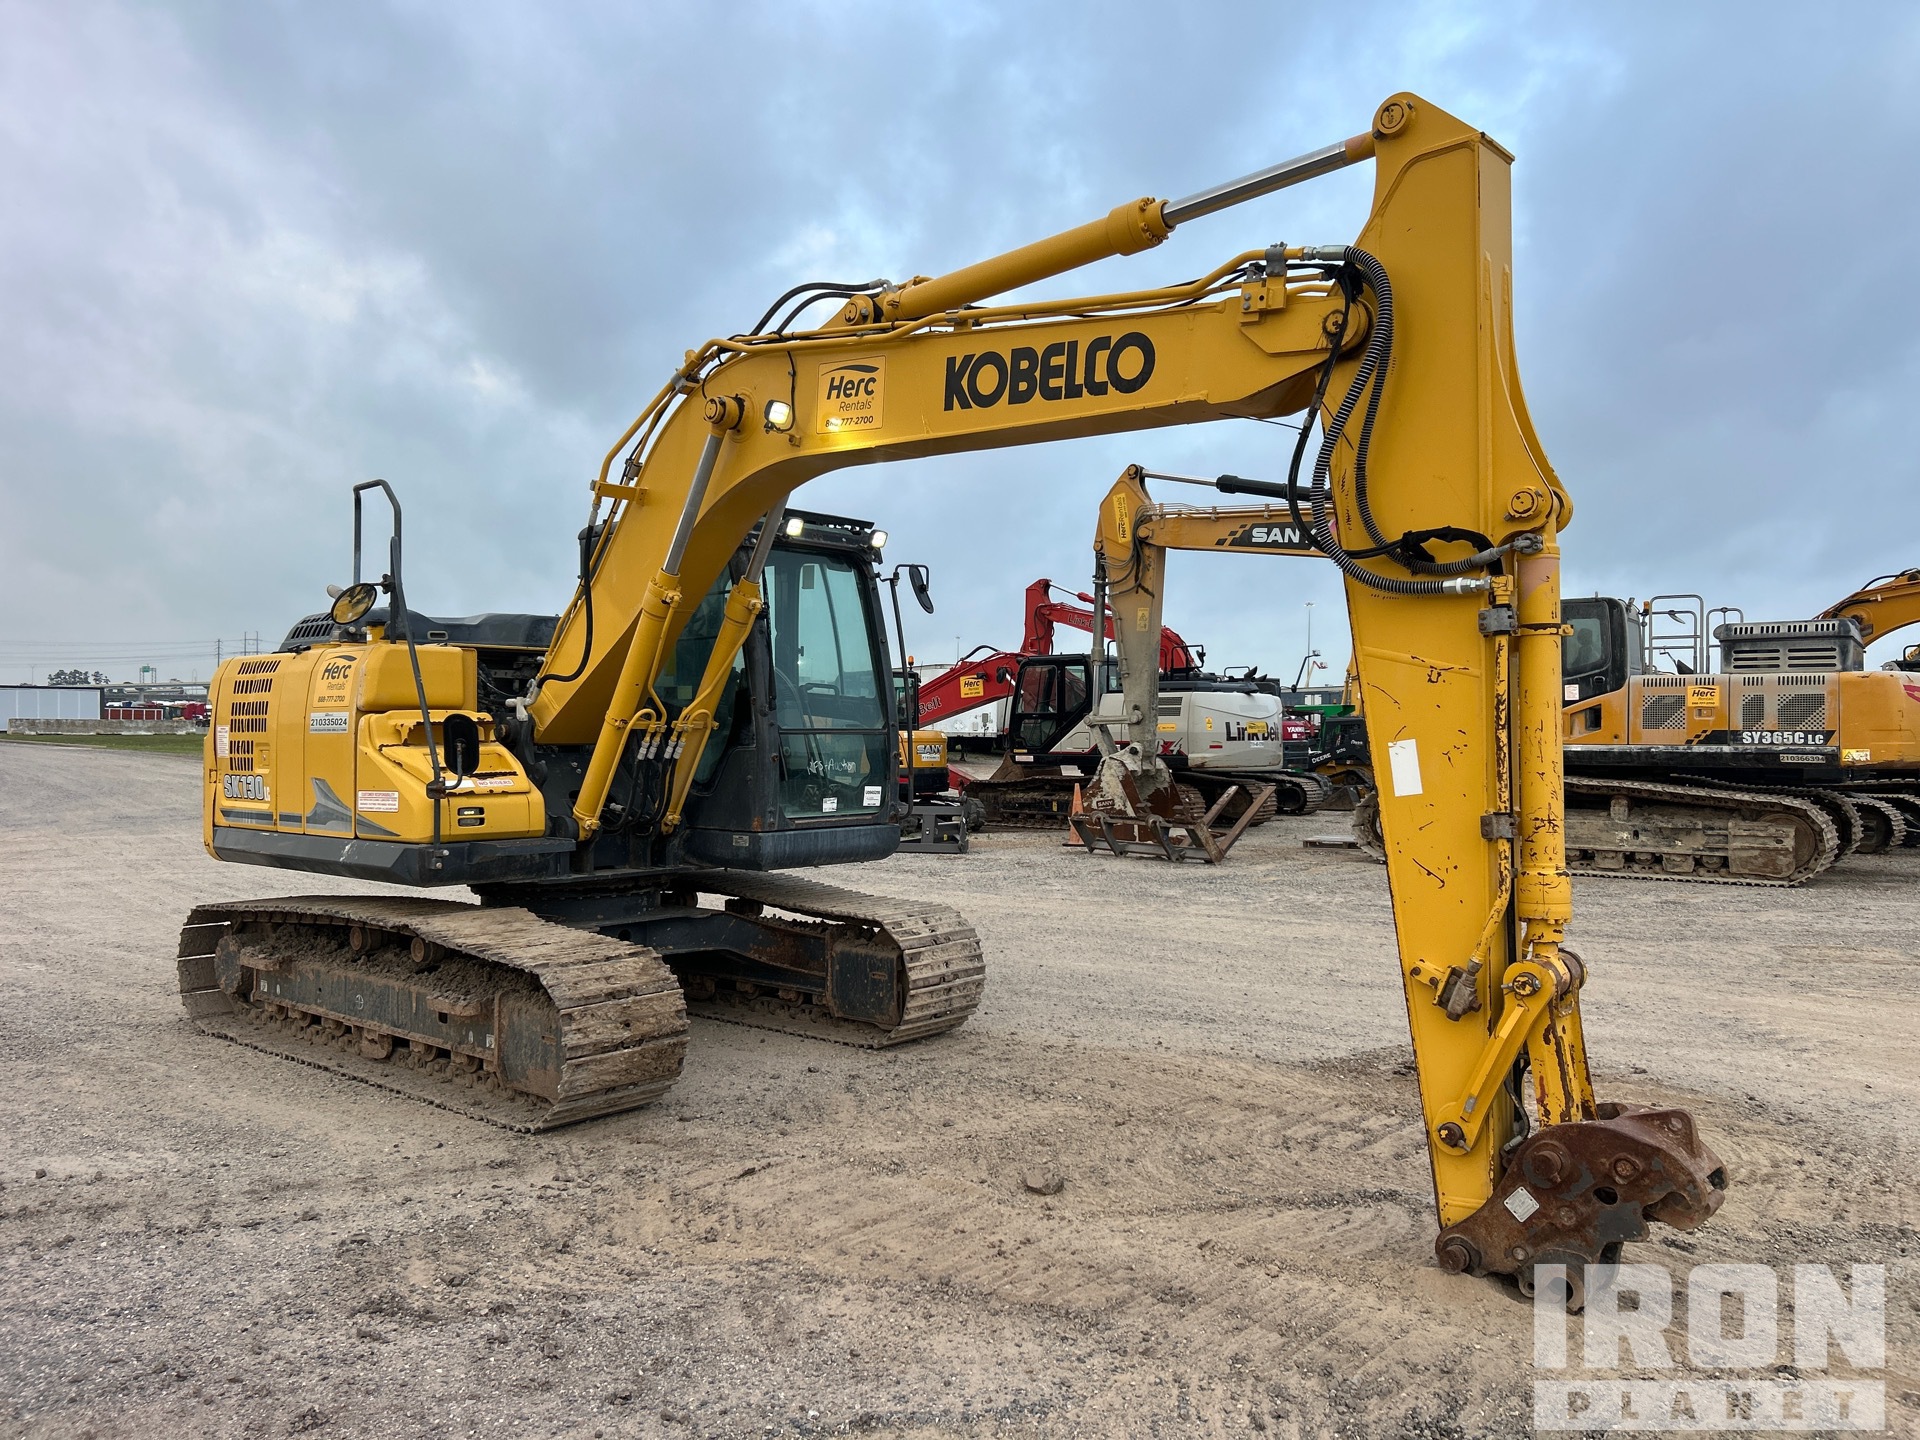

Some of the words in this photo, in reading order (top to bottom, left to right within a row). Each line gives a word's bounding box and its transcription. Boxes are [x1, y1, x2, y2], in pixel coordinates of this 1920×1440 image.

[944, 332, 1156, 411] KOBELCO
[826, 376, 877, 400] Herc
[839, 399, 872, 412] Rentals
[1251, 527, 1318, 543] SAN
[321, 662, 352, 681] Herc
[327, 681, 346, 690] Rentals
[963, 680, 981, 688] Herc
[1691, 689, 1716, 697] Herc
[310, 718, 348, 727] 210335024
[1225, 721, 1280, 741] LinkBelt
[1742, 731, 1805, 744] SY365C
[1807, 734, 1824, 745] LC
[917, 745, 943, 755] SANY
[1311, 752, 1332, 764] DEERE
